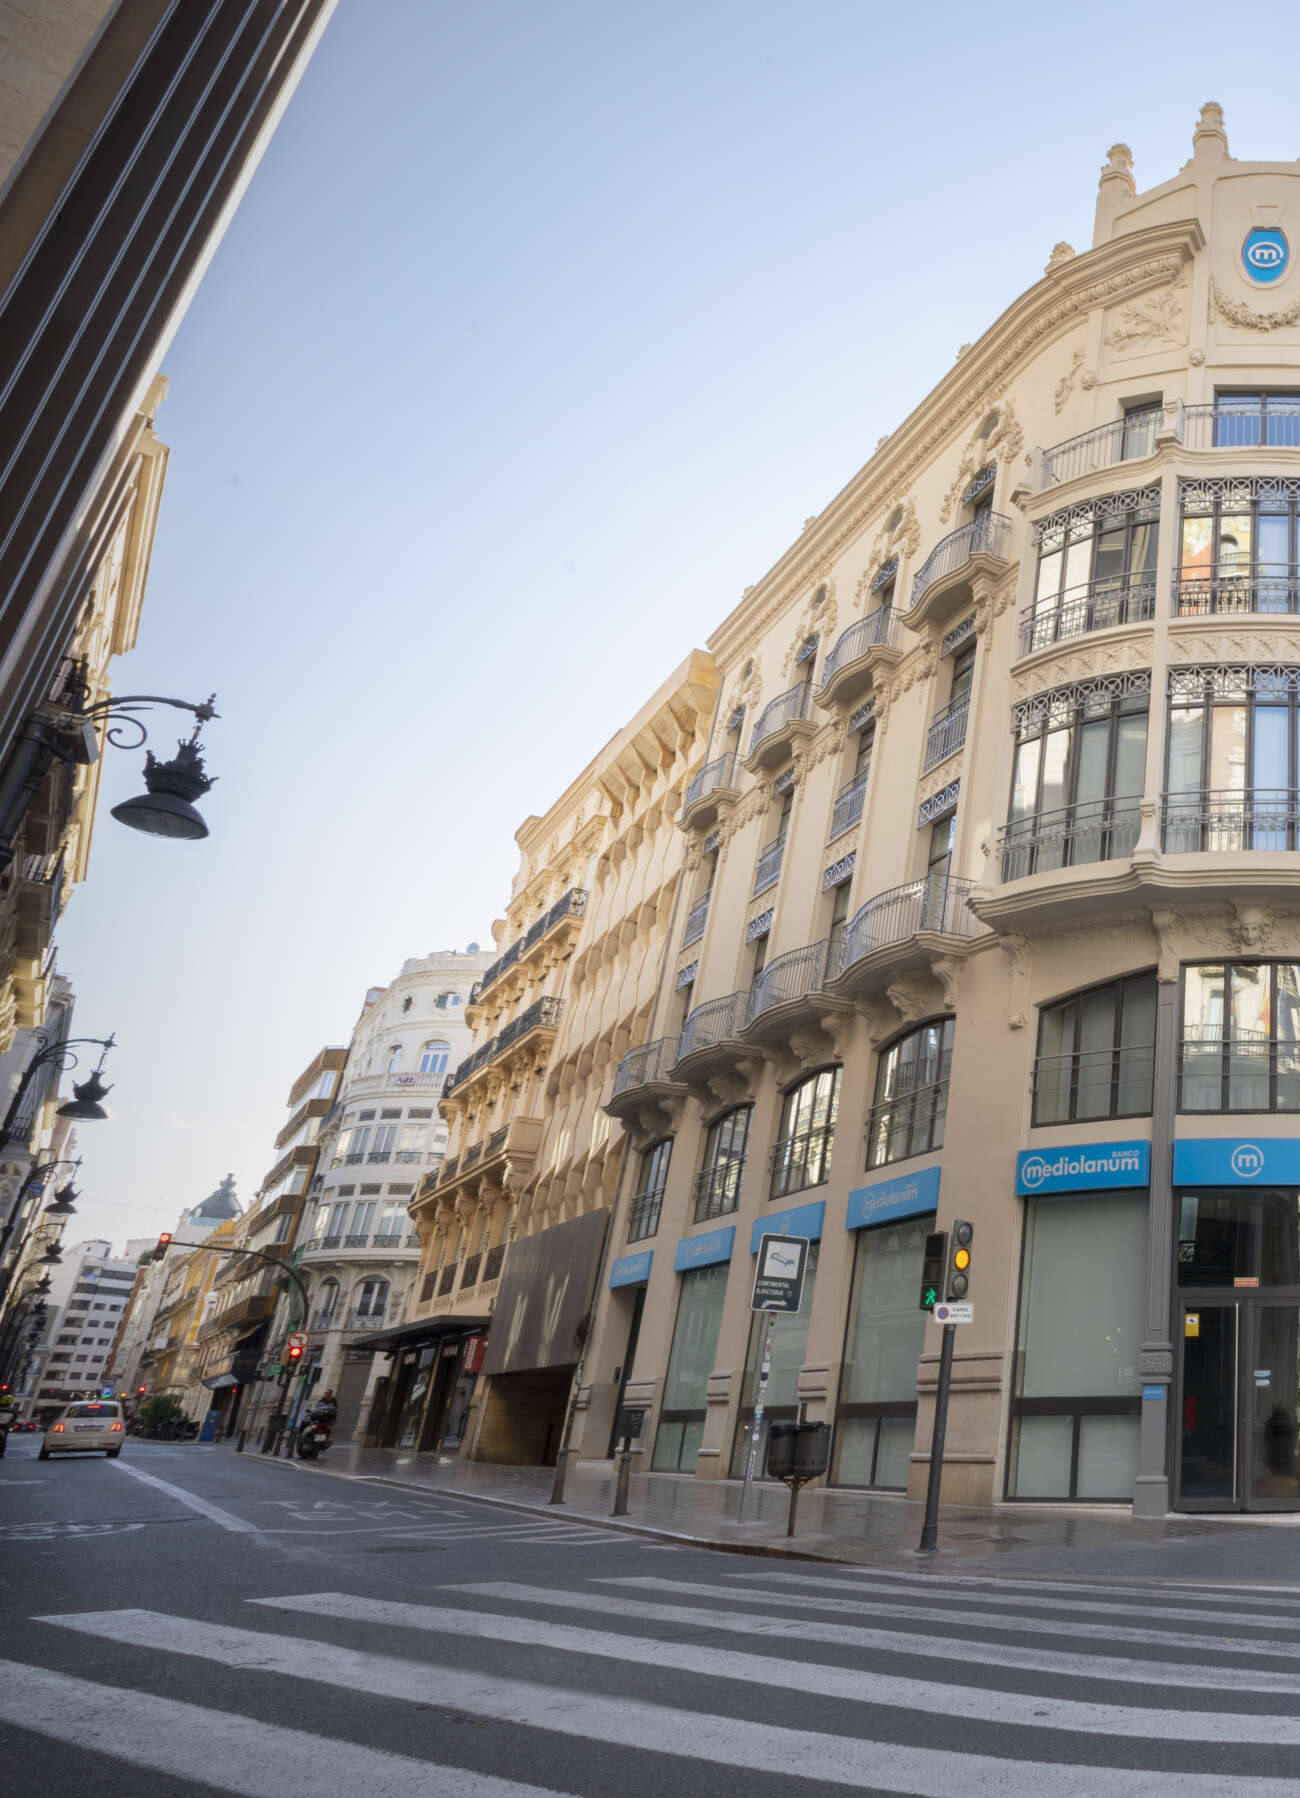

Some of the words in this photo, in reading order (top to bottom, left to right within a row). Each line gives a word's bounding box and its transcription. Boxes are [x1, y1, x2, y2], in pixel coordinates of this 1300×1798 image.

[1112, 1150, 1140, 1158] BANCO
[1025, 1155, 1140, 1180] mediolanum
[287, 1510, 471, 1521] EMT
